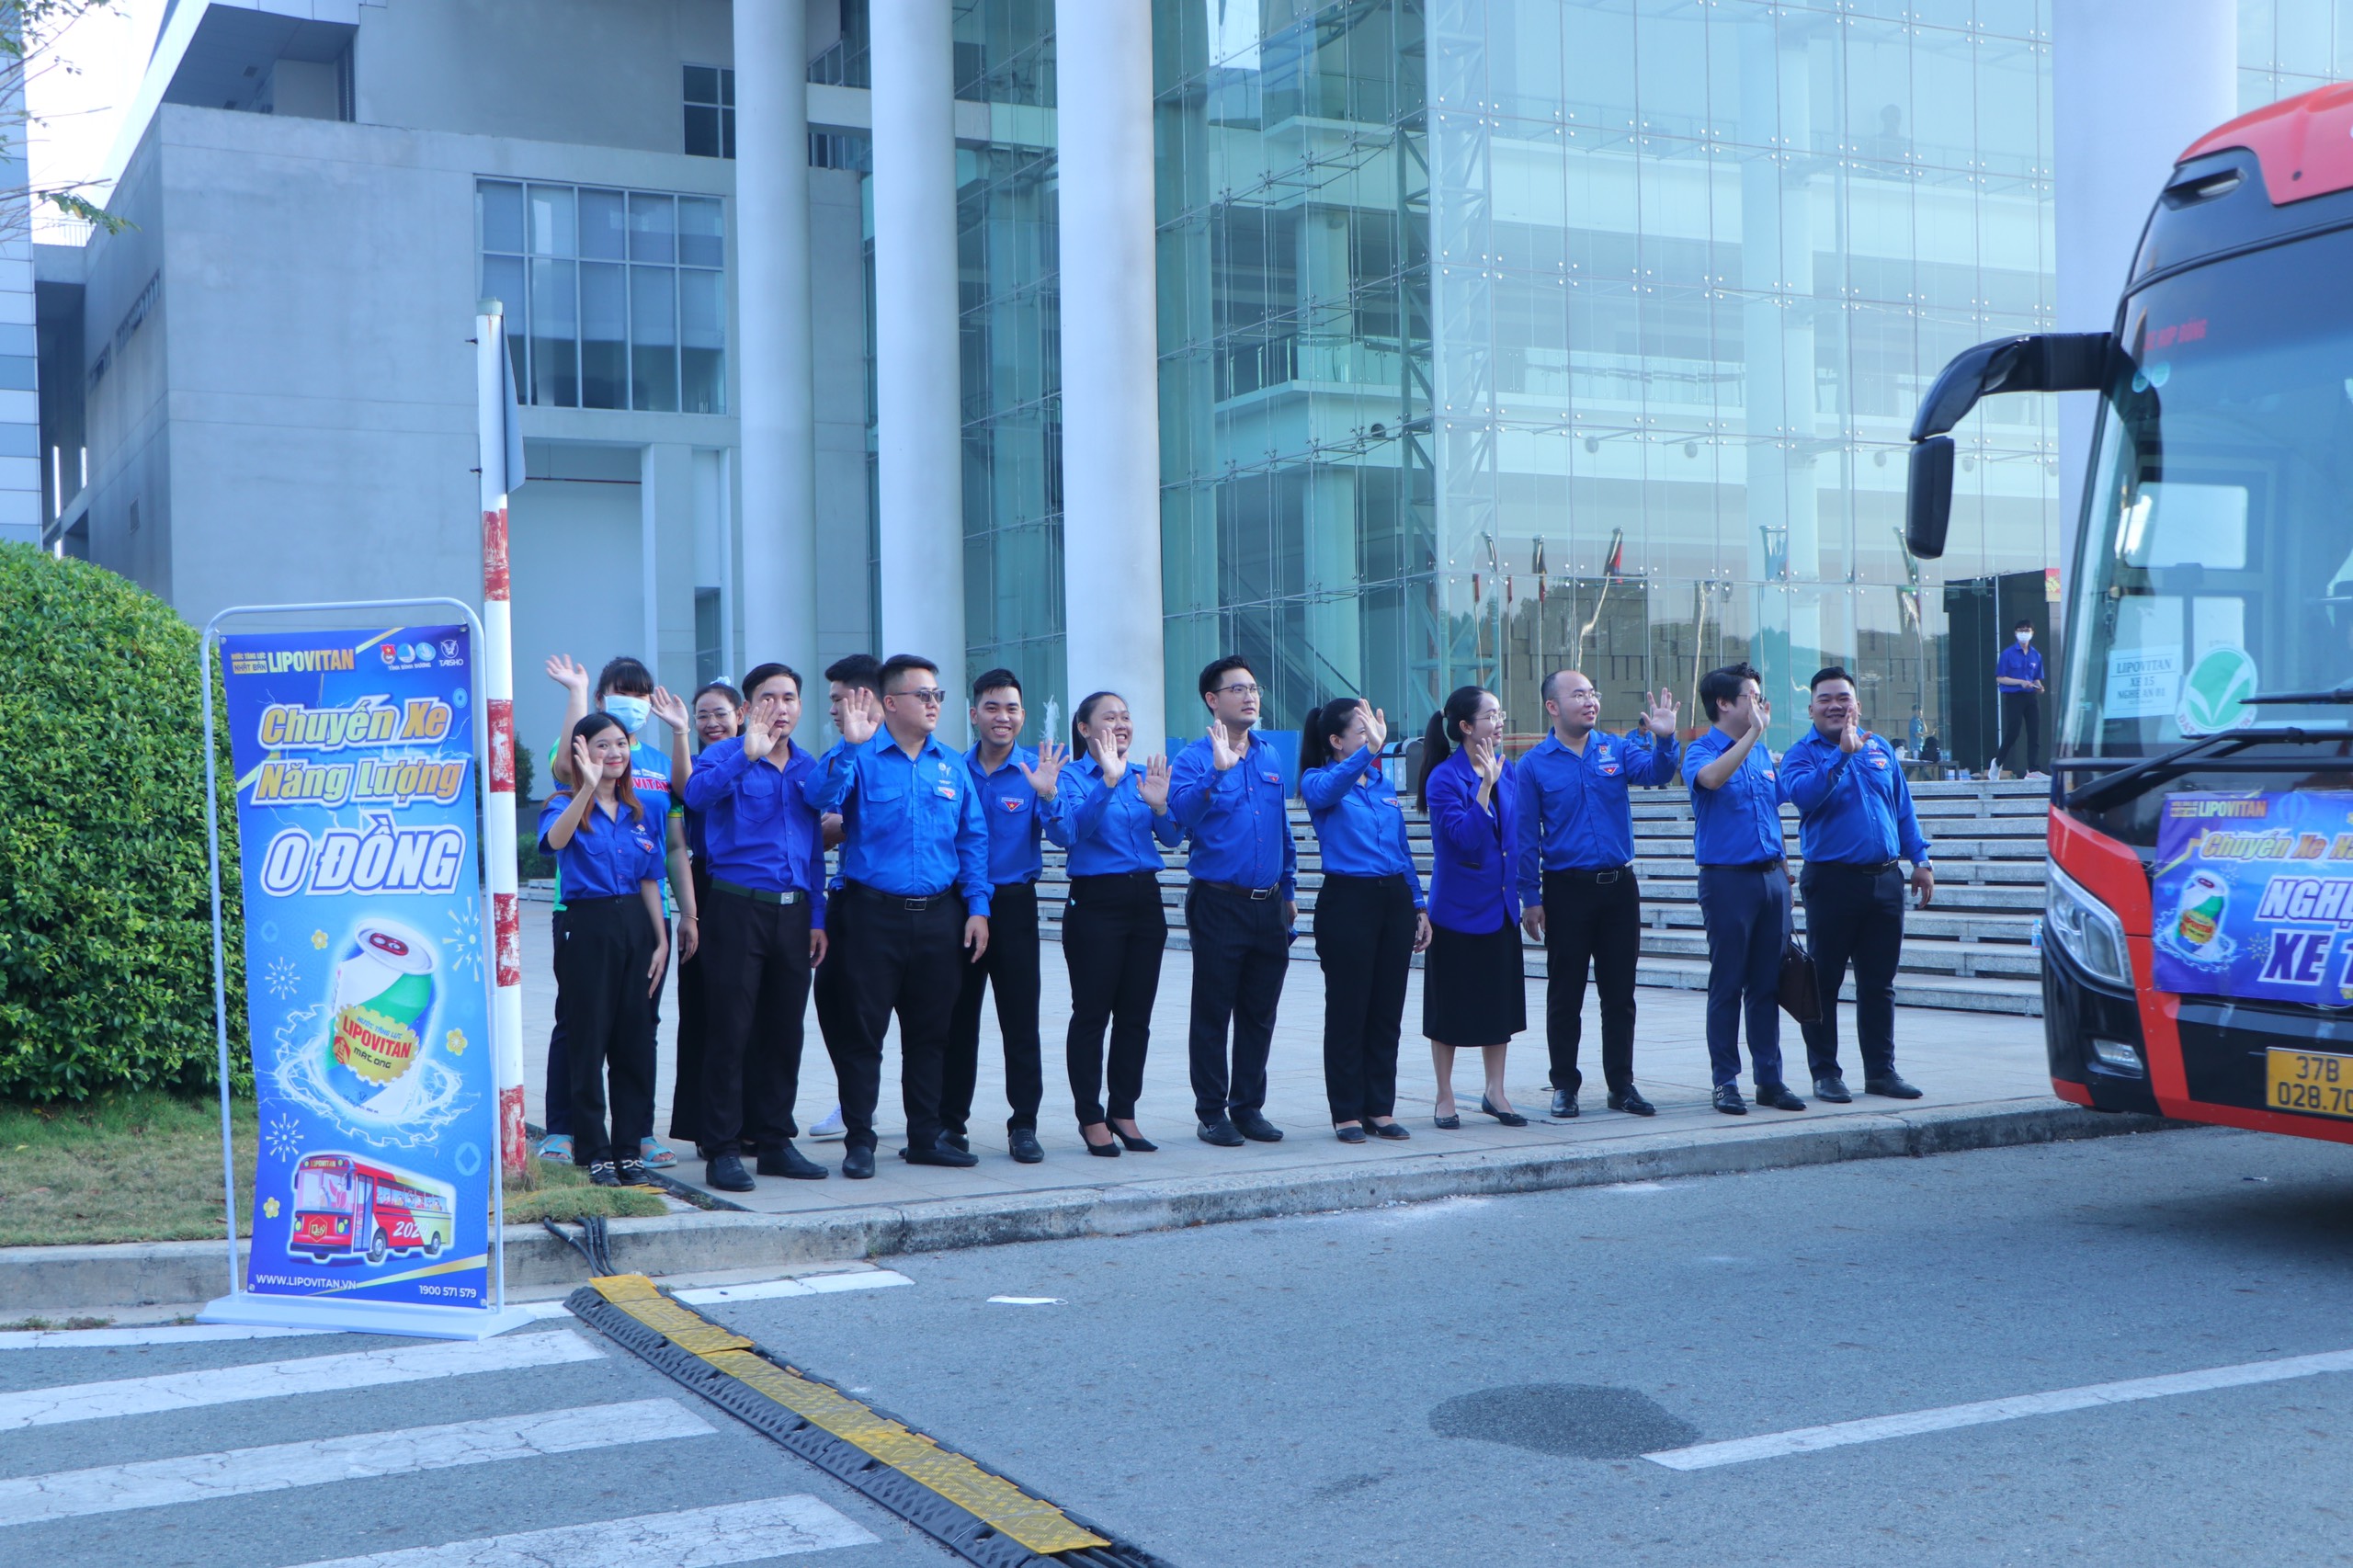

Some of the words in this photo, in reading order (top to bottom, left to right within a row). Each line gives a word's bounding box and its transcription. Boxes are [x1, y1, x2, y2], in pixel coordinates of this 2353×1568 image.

[267, 649, 355, 673] LIPOVITAN
[439, 658, 464, 666] TAISHO
[2117, 658, 2172, 674] LIPOVITAN
[260, 699, 397, 747] Chuyến
[399, 700, 449, 740] Xe
[256, 762, 351, 803] Năng
[355, 759, 462, 804] Lượng
[631, 777, 671, 793] VITAN
[2198, 801, 2268, 817] LIPOVITAN
[311, 813, 463, 891] ĐỒNG
[2201, 829, 2292, 860] Chuyến
[2292, 834, 2327, 859] Xe
[2263, 932, 2332, 983] XE
[343, 1014, 413, 1059] LIPOVITAN
[2295, 1055, 2339, 1083] 37B
[392, 1221, 430, 1239] 2024
[256, 1273, 358, 1290] WWW.LIPOVITAN.VN
[418, 1284, 441, 1296] 1900
[442, 1286, 458, 1297] 571
[459, 1288, 477, 1299] 579
